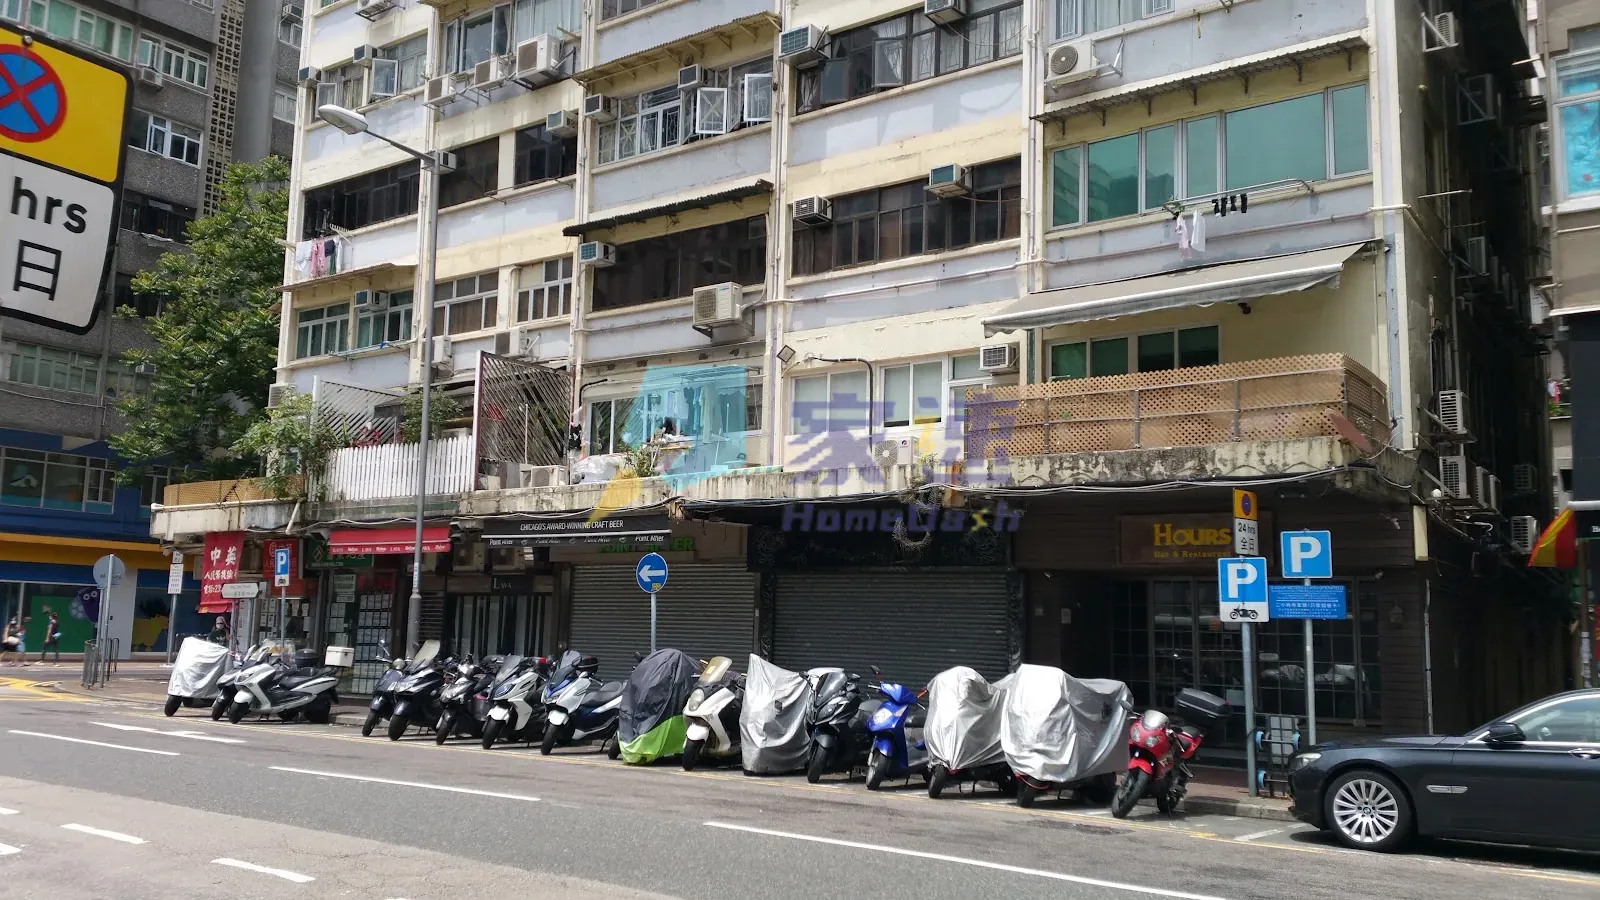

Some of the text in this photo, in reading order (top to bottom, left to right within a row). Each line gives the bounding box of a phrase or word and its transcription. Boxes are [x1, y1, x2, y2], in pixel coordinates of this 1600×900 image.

[10, 176, 88, 234] hrs
[13, 239, 62, 301] 日
[520, 519, 624, 531] CHICAGO'S AWARD-WINNING CRAFT BEER
[1238, 522, 1256, 534] 24 hrs
[1240, 537, 1255, 551] 全日
[1290, 536, 1322, 573] P
[210, 545, 237, 566] 中英
[276, 552, 287, 573] P
[1227, 563, 1258, 599] P
